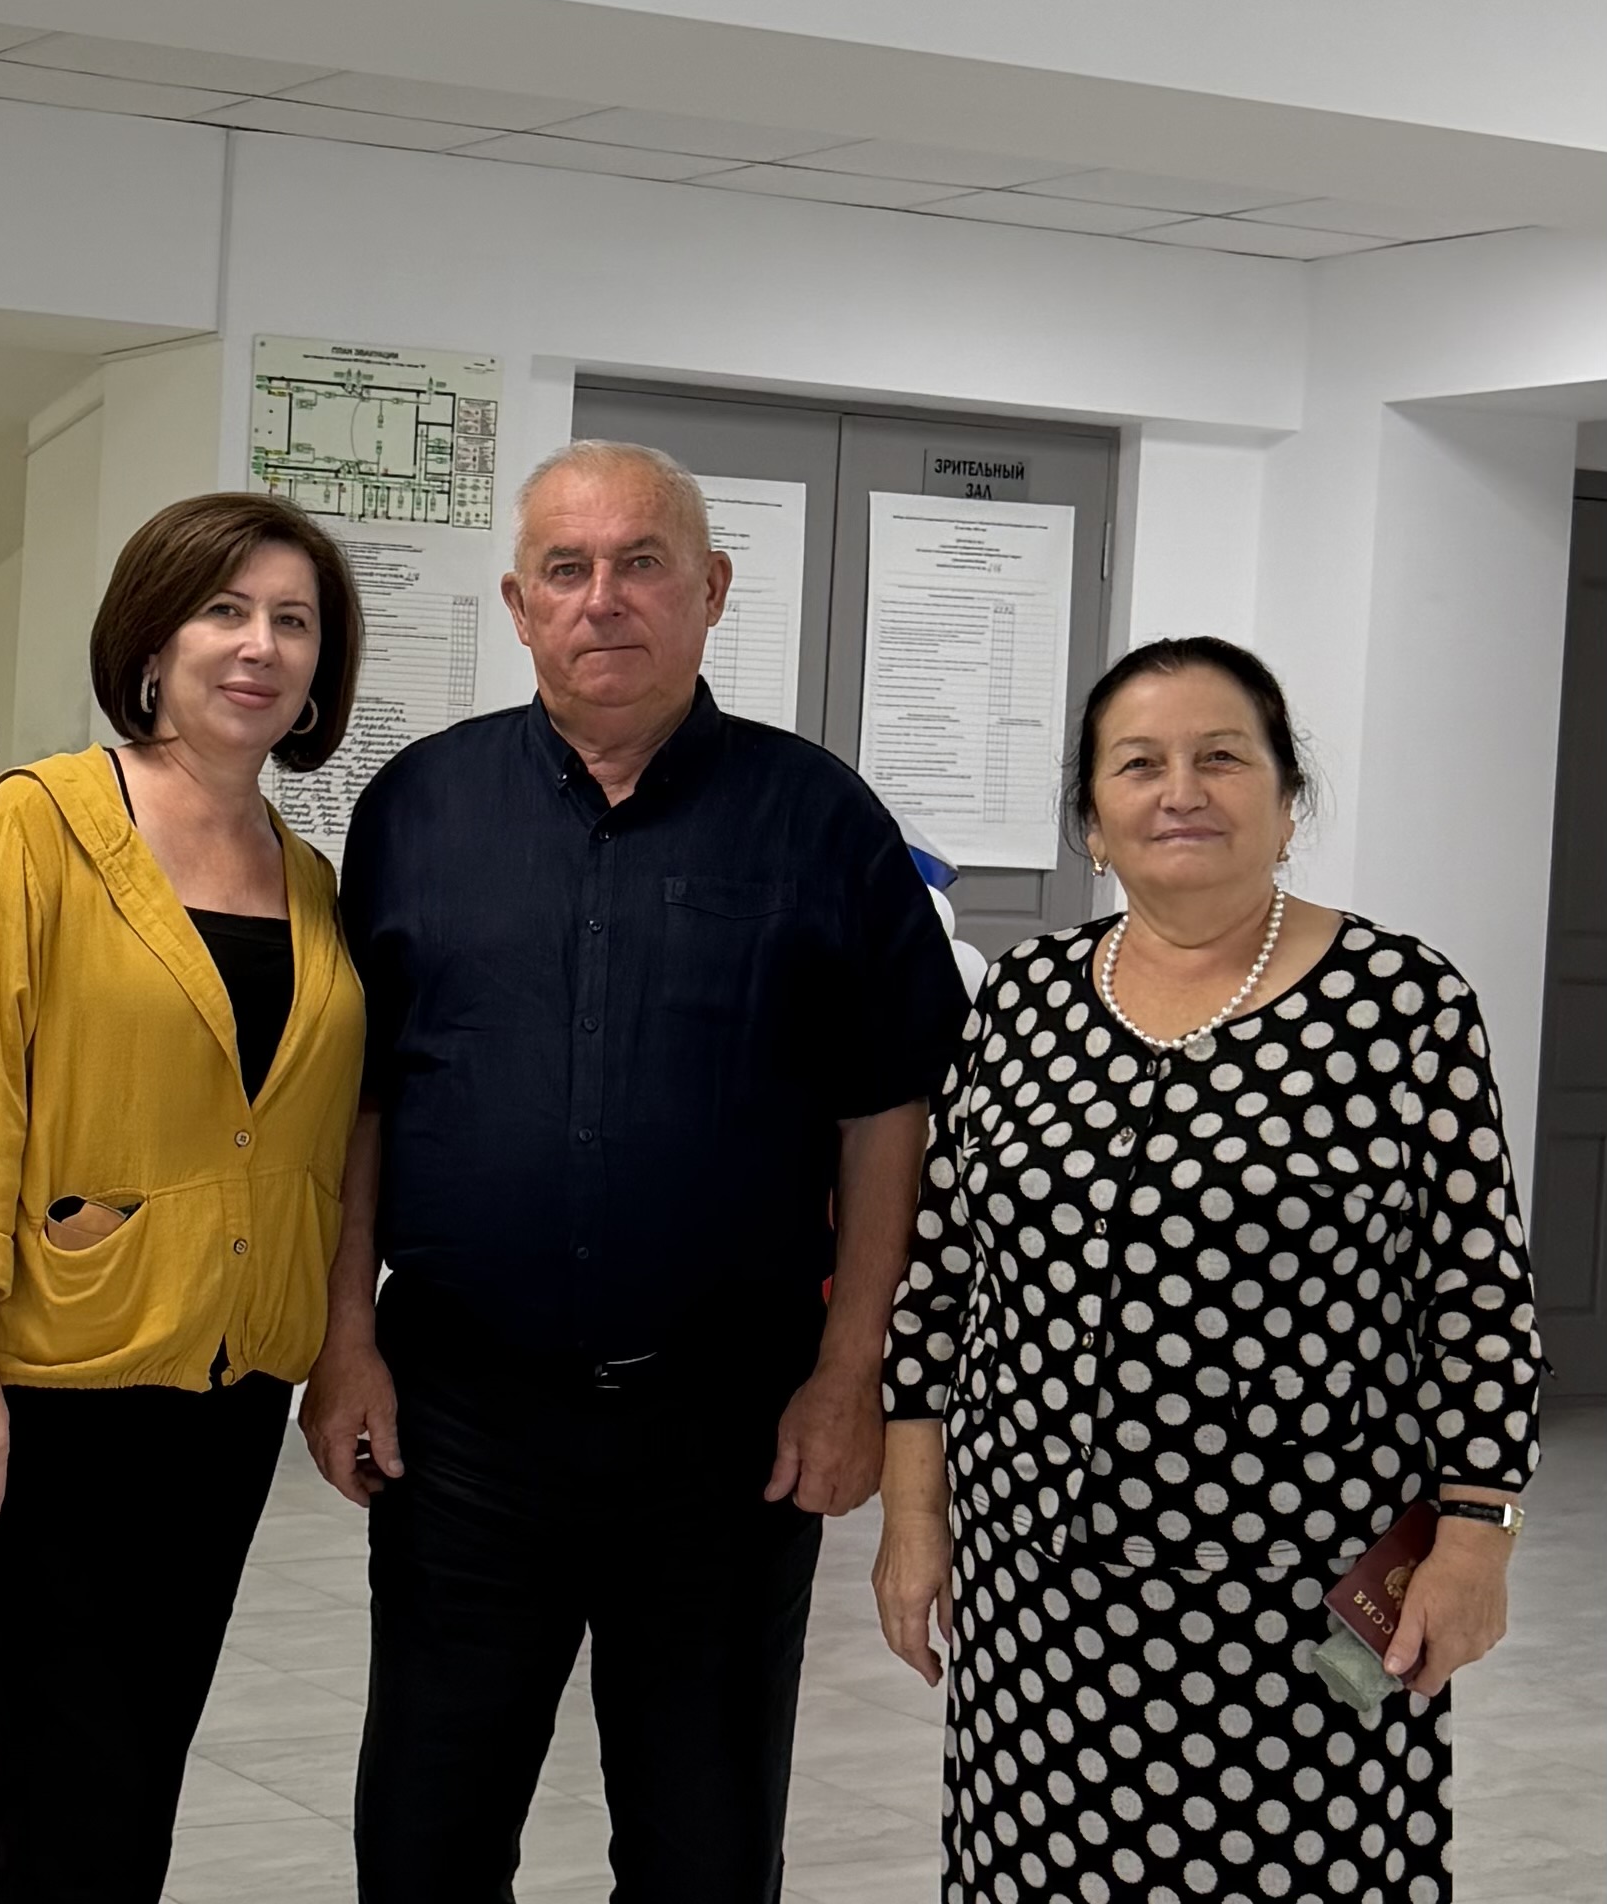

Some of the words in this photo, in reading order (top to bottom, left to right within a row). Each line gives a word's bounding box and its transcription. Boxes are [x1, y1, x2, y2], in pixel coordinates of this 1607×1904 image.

[934, 458, 1025, 480] ЗРИТЕЛЬНЫЙ
[965, 483, 992, 500] ЗАЛ
[1353, 1590, 1394, 1634] ССИЯ
